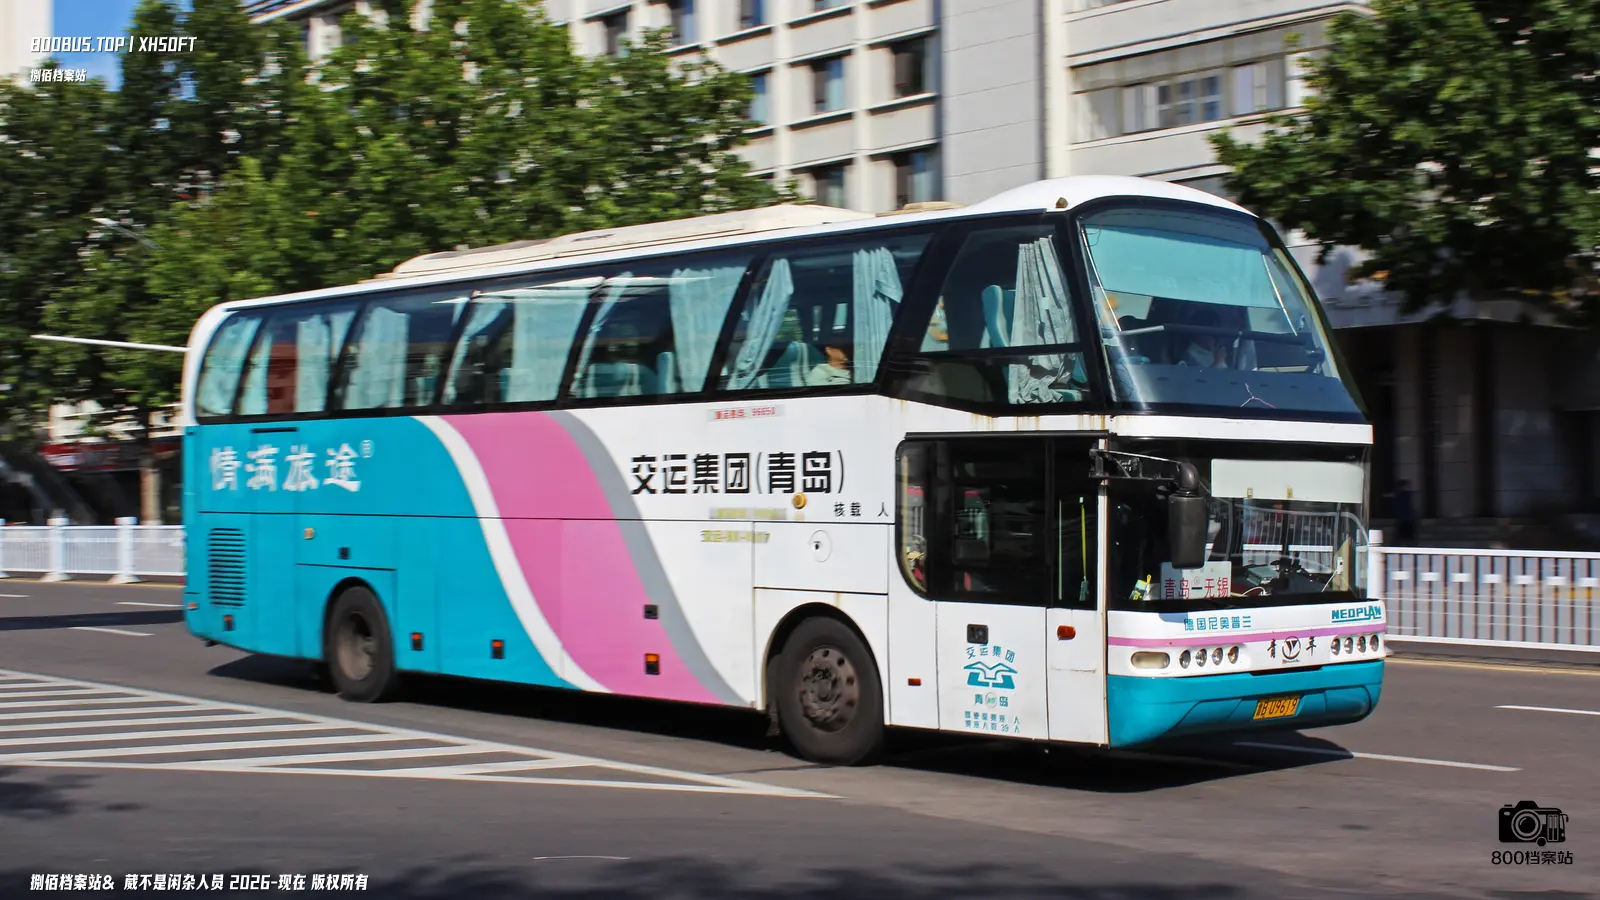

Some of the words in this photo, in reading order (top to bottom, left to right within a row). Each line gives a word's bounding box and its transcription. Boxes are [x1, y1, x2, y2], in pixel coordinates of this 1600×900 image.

[209, 443, 363, 492] 情满旅途
[877, 502, 889, 516] 人
[1331, 605, 1382, 620] NEOPLAN
